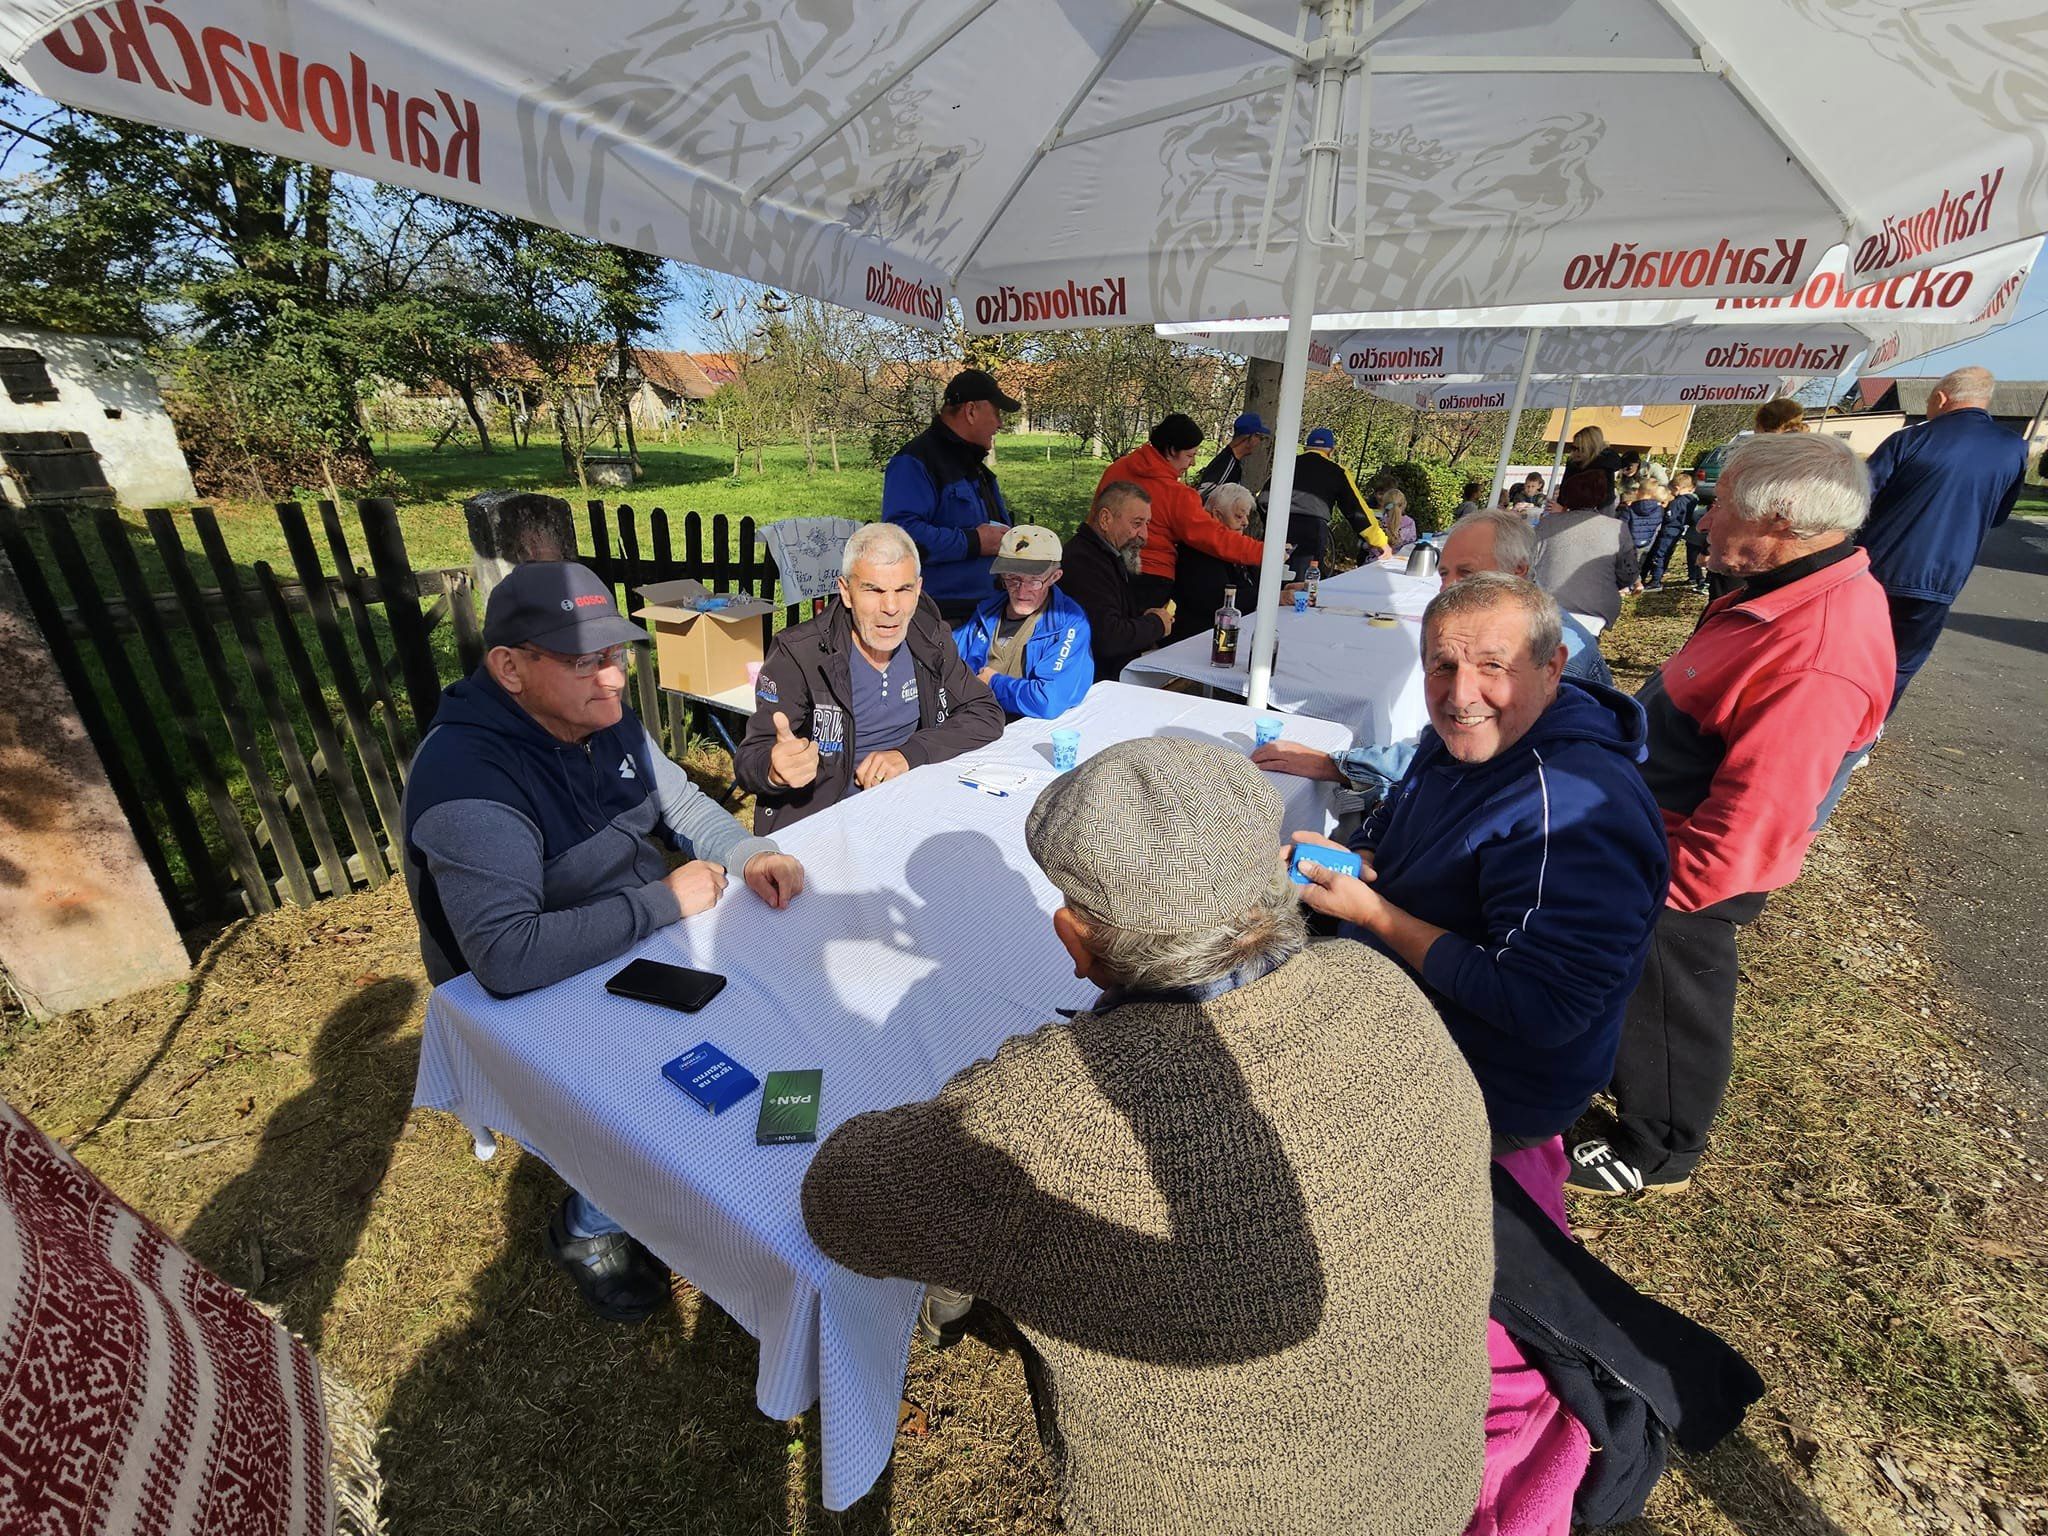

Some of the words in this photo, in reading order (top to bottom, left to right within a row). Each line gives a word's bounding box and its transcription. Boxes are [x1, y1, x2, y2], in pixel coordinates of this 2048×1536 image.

[575, 594, 607, 608] BOSCH
[691, 1061, 726, 1083] sigurno
[698, 1079, 711, 1089] na
[777, 1094, 812, 1105] PAN
